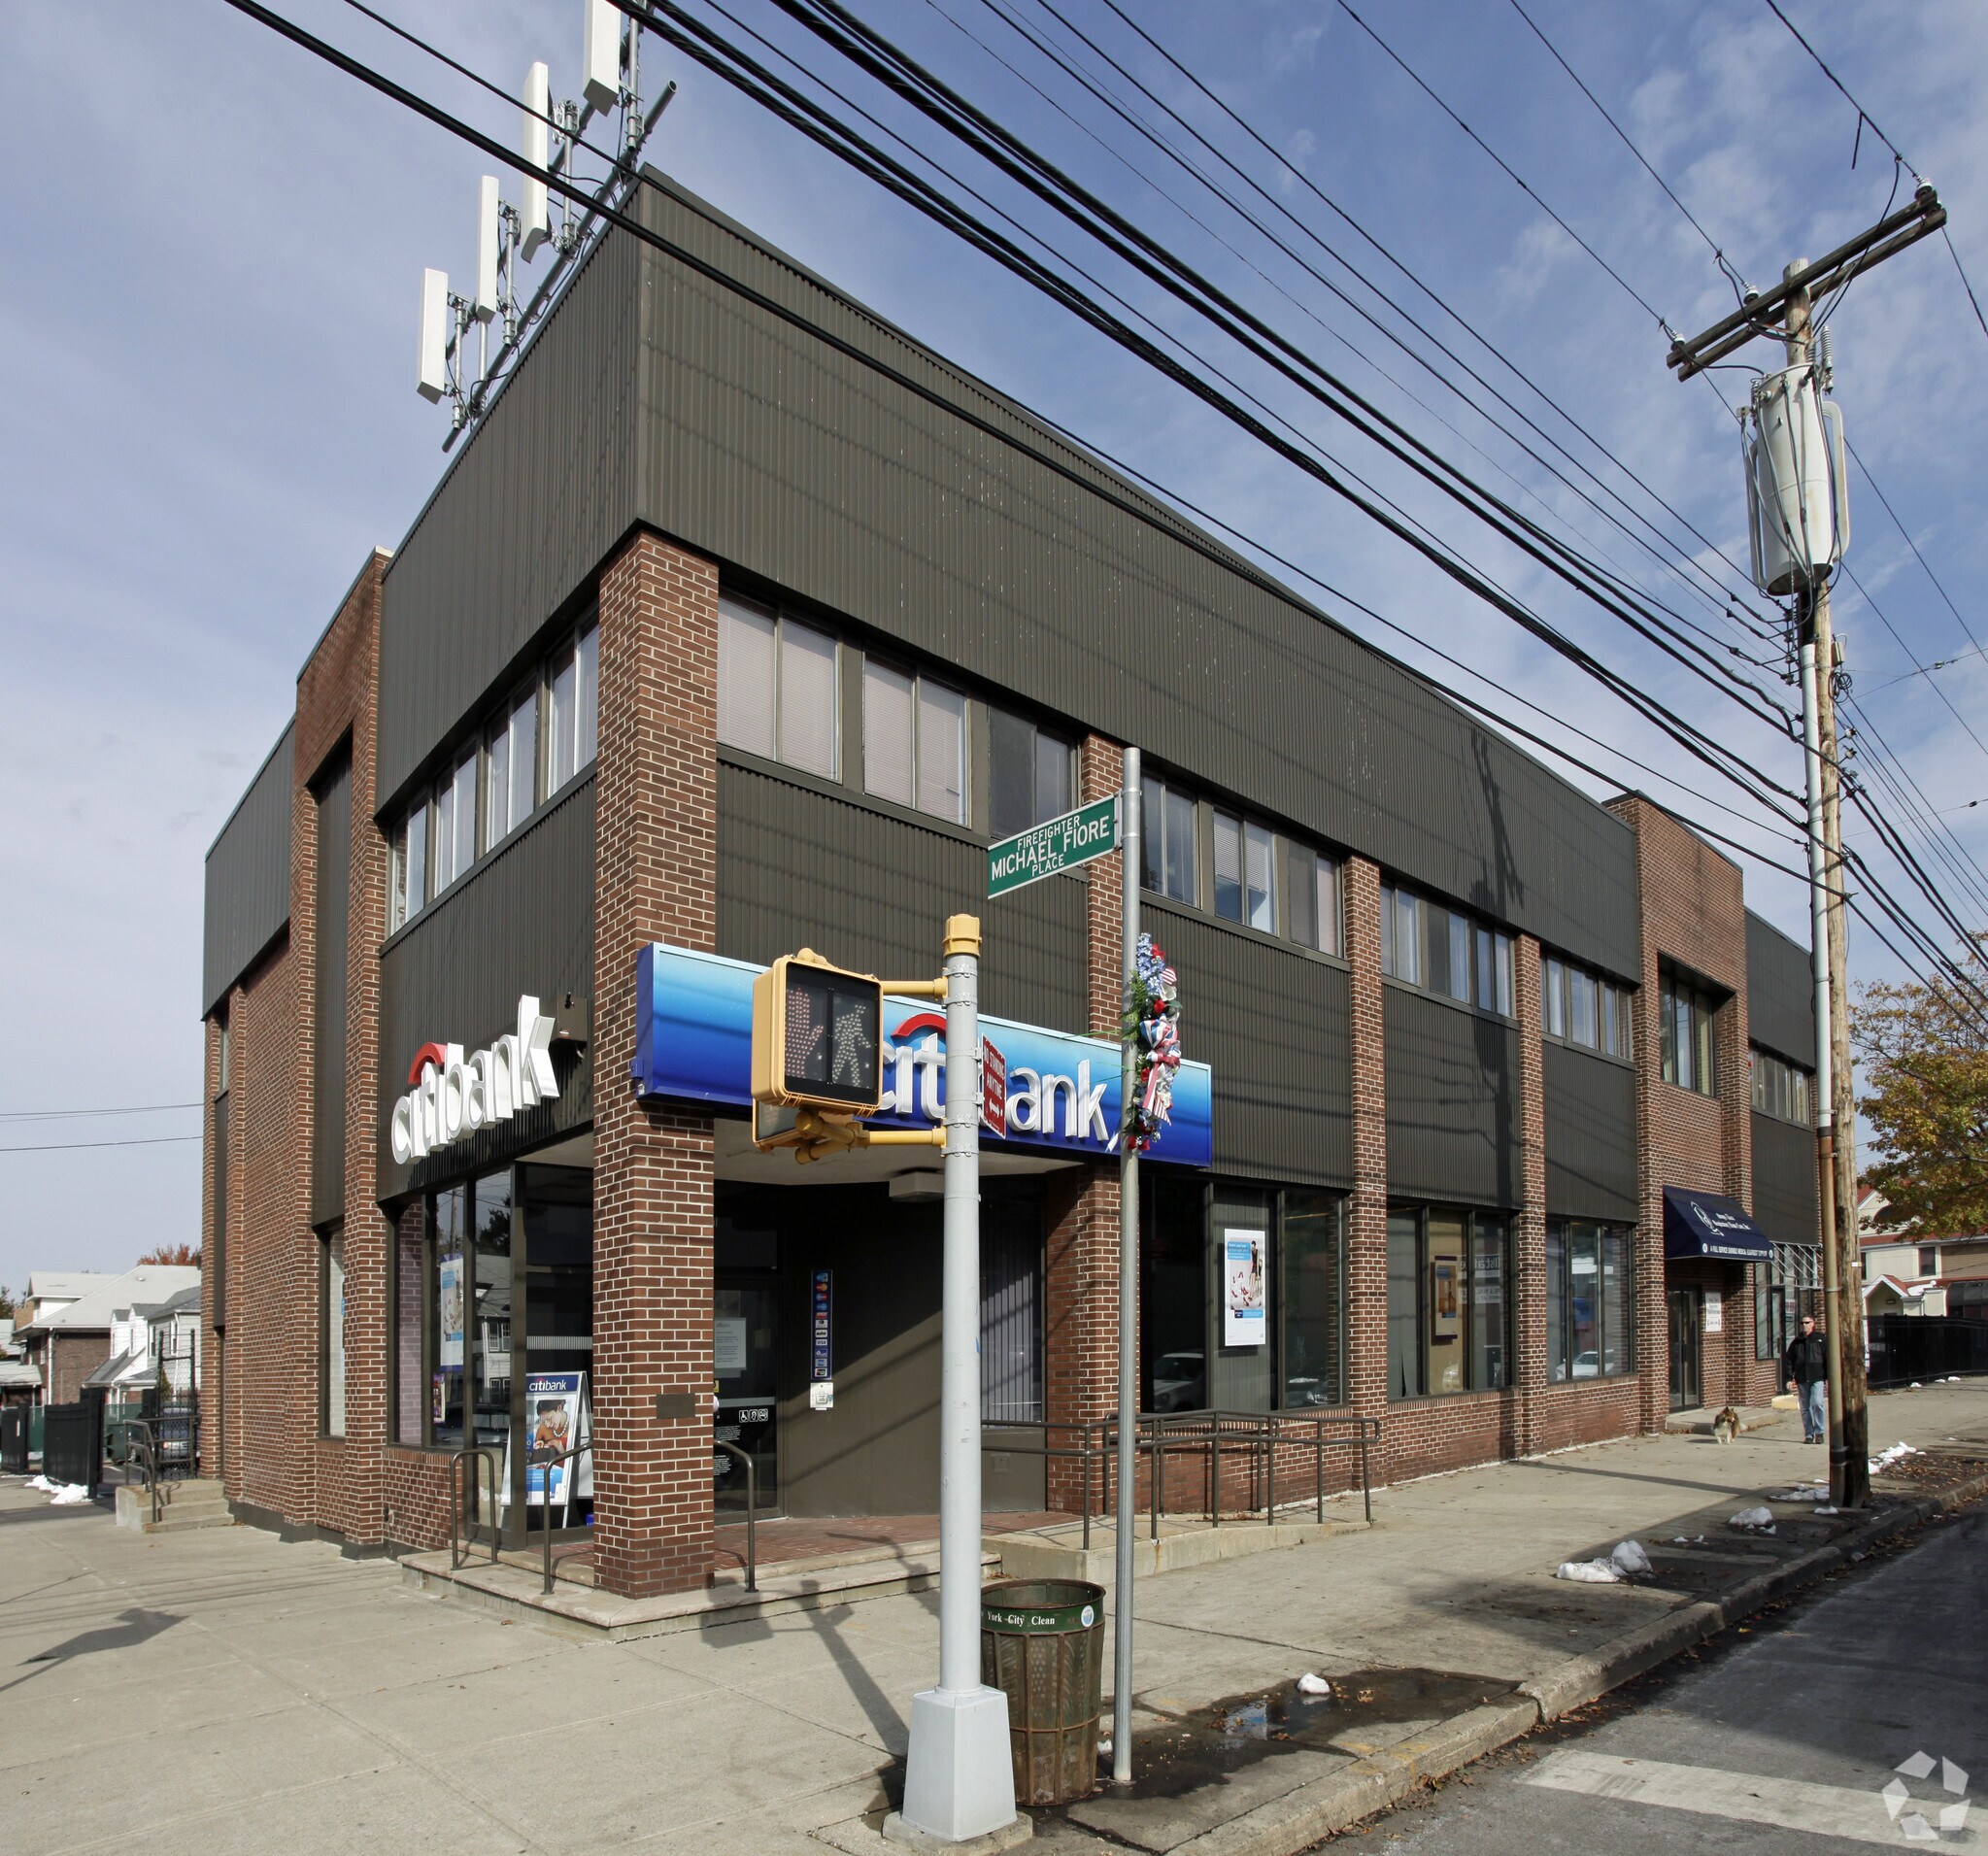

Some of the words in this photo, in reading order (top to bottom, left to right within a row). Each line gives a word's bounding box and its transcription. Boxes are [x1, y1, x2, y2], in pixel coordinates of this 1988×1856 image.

[1018, 815, 1080, 851] FIREFIGHTER
[992, 841, 1057, 881] MICHAEL
[1063, 815, 1109, 853] FIORE
[1031, 854, 1064, 877] PLACE
[391, 995, 559, 1164] citibank
[987, 1071, 1002, 1099] ANYTIME
[529, 1379, 566, 1392] citibank
[987, 1610, 1002, 1623] York
[1007, 1614, 1025, 1627] City
[1031, 1615, 1055, 1626] Clean
